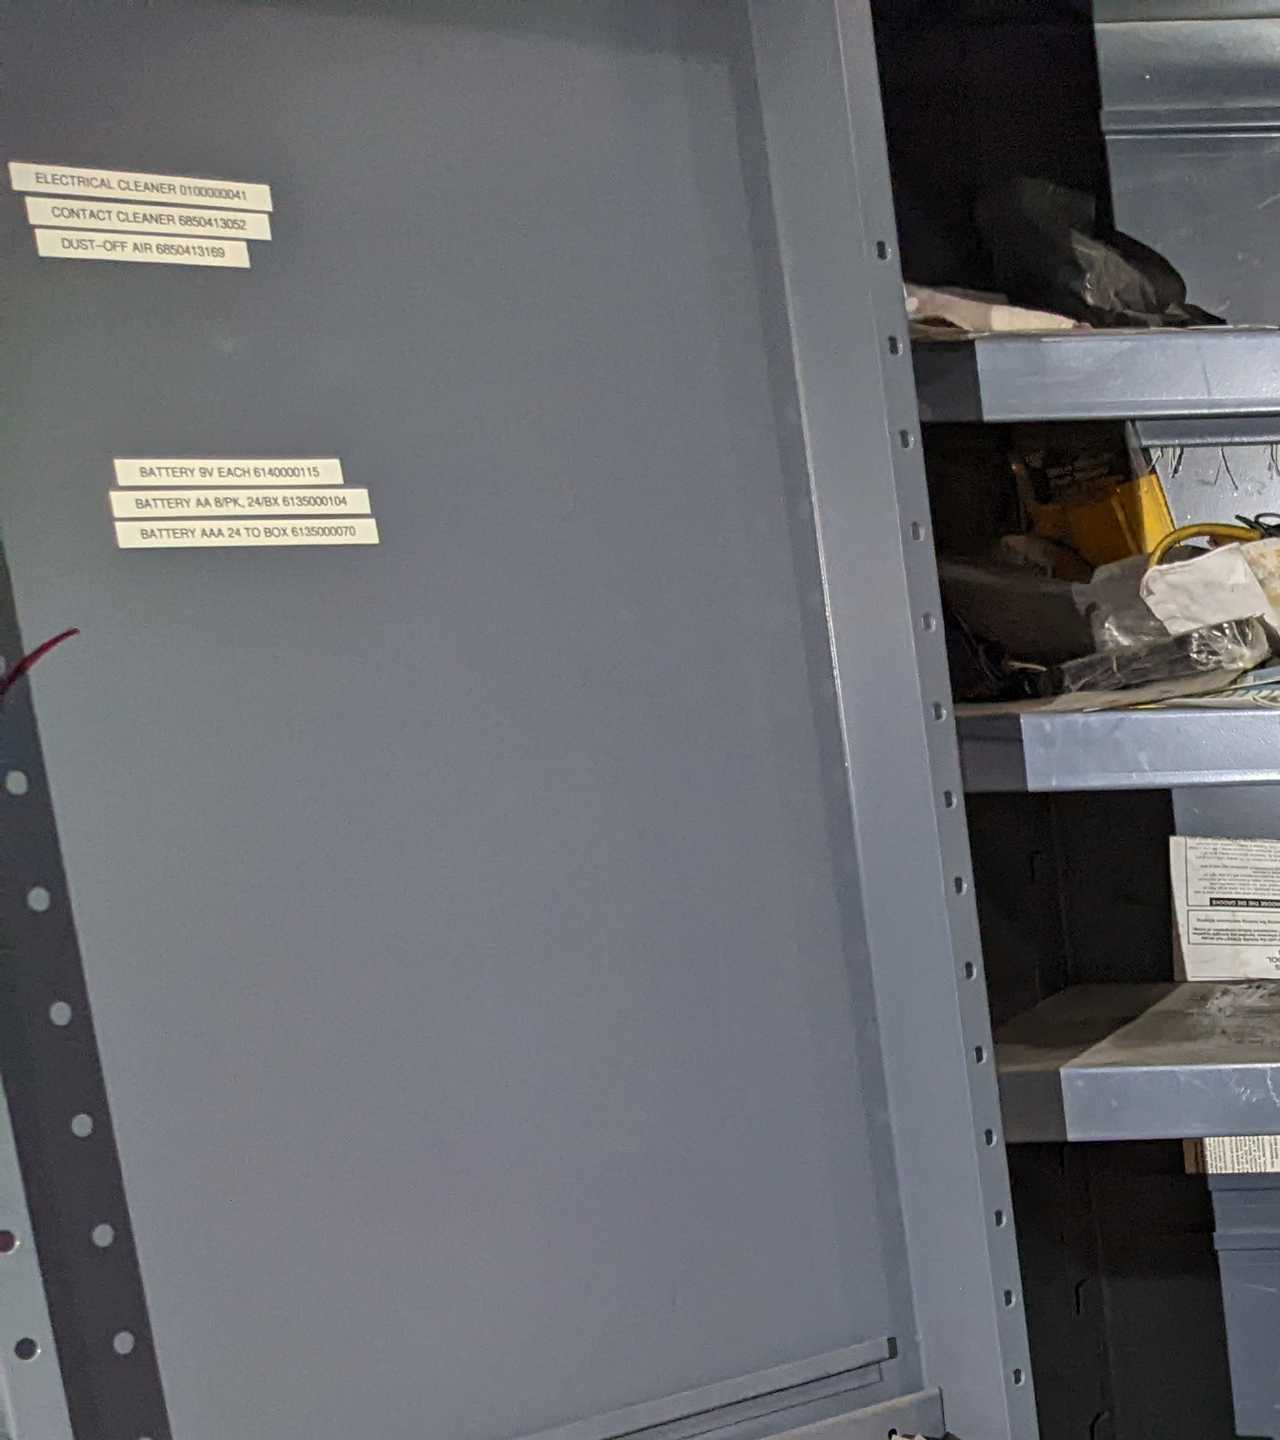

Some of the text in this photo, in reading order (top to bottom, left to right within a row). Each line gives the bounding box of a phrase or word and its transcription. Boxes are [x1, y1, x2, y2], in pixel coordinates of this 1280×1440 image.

[35, 172, 113, 190] ELECTRICAL
[117, 179, 177, 195] CLEANER
[51, 206, 247, 230] CONTACT CLEANER 6850413052
[61, 237, 225, 258] DUST-OFF AIR 6850413169
[140, 466, 320, 479] BATTERY 9V EACH 6140000115
[135, 497, 191, 509] BATTERY
[196, 497, 213, 509] AA
[248, 496, 280, 507] 24/BX
[282, 495, 347, 507] 6135000104
[140, 526, 356, 540] BATTERY AAA 24 TO BOX 6135000070
